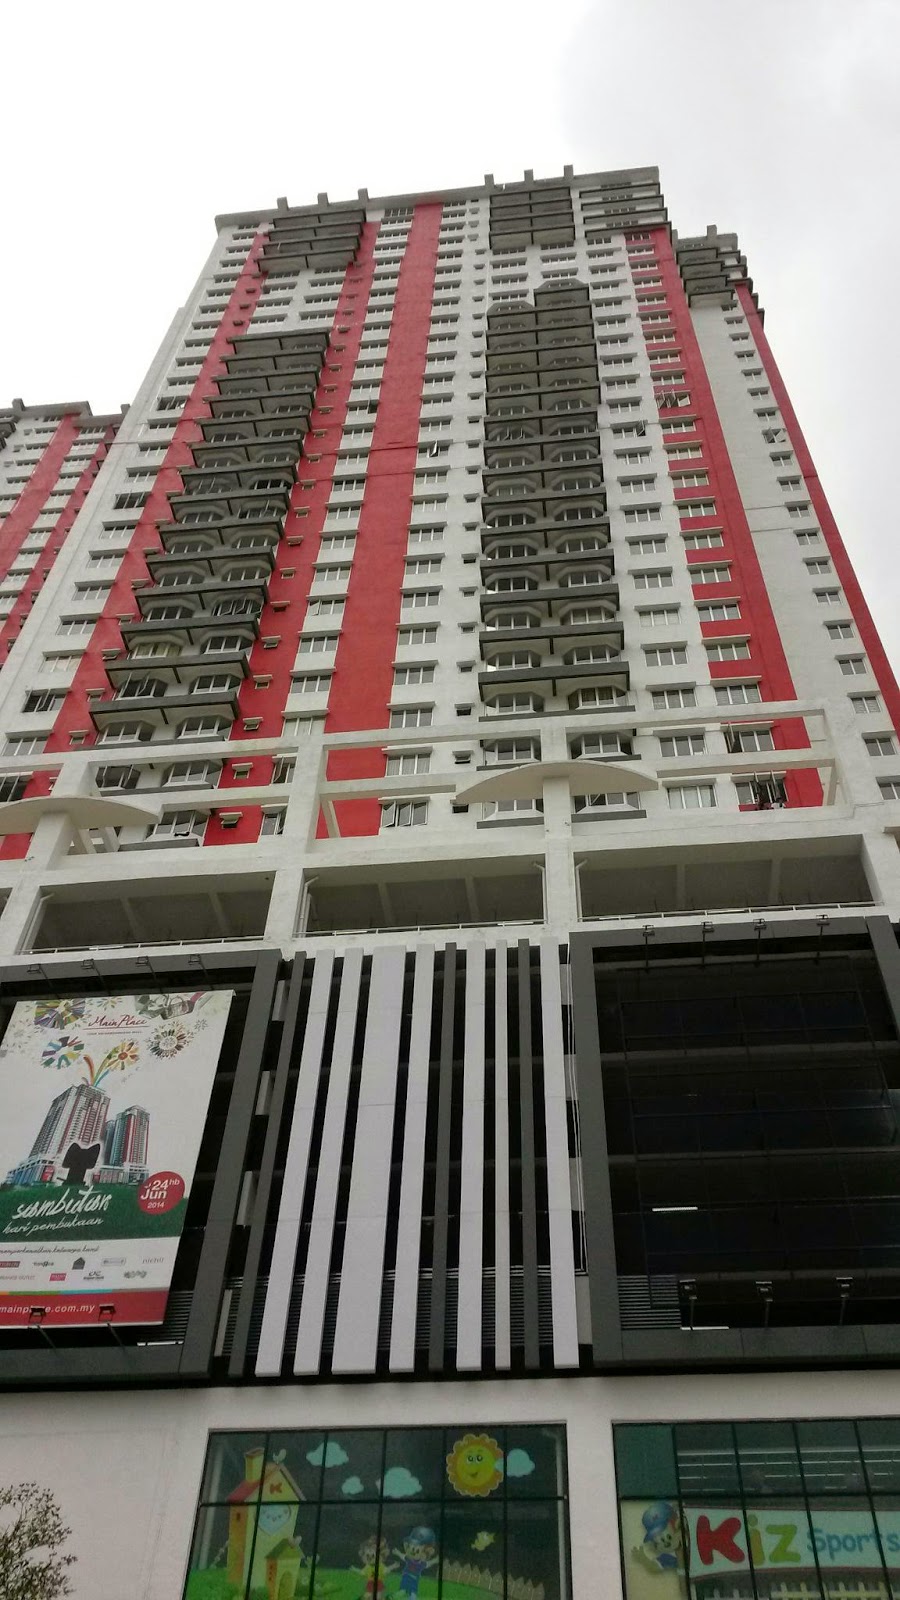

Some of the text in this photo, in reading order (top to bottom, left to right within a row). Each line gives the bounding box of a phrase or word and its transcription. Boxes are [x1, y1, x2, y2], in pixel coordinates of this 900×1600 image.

[12, 1185, 113, 1220] sambutan
[140, 1188, 168, 1200] Jun
[147, 1201, 165, 1209] 2014
[2, 1214, 104, 1237] hari pembukaan
[696, 1515, 801, 1566] Kiz
